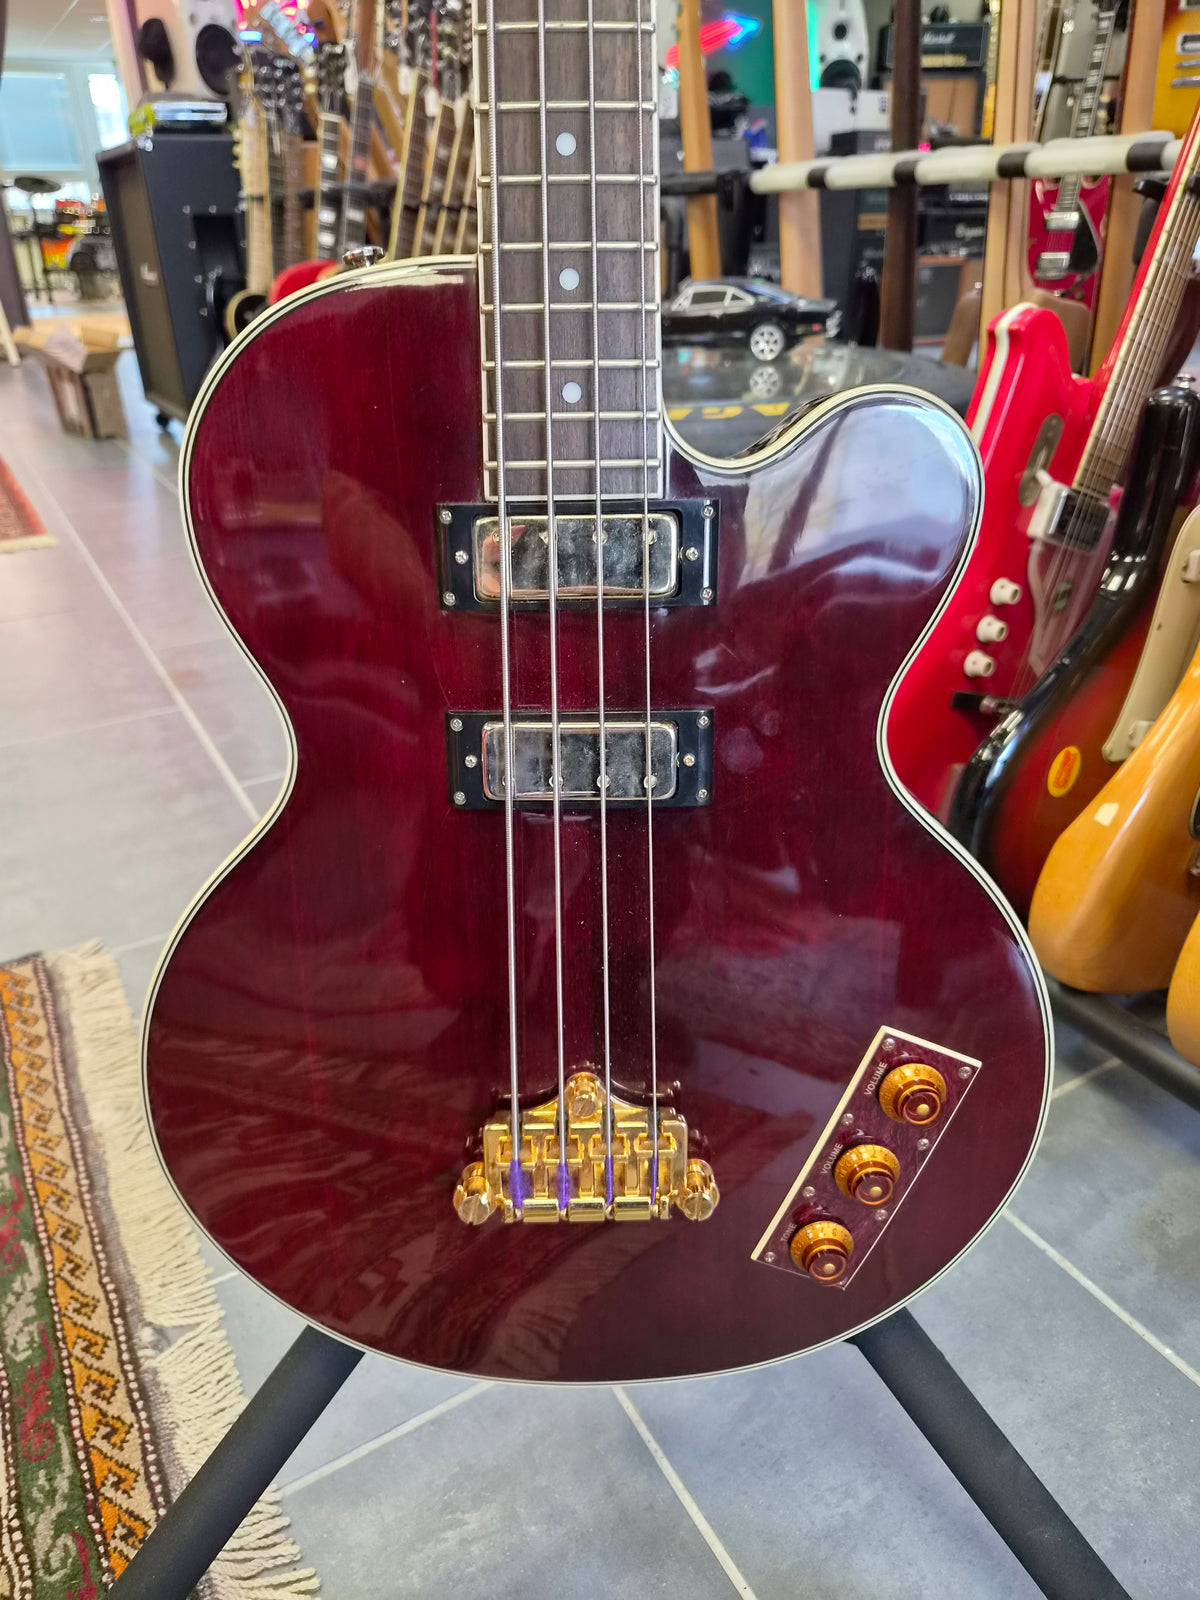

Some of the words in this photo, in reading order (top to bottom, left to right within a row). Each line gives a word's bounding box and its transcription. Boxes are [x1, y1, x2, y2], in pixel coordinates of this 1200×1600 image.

[863, 1061, 888, 1095] VOLUME
[820, 1142, 844, 1174] VOLUME
[780, 1222, 797, 1242] TONE
